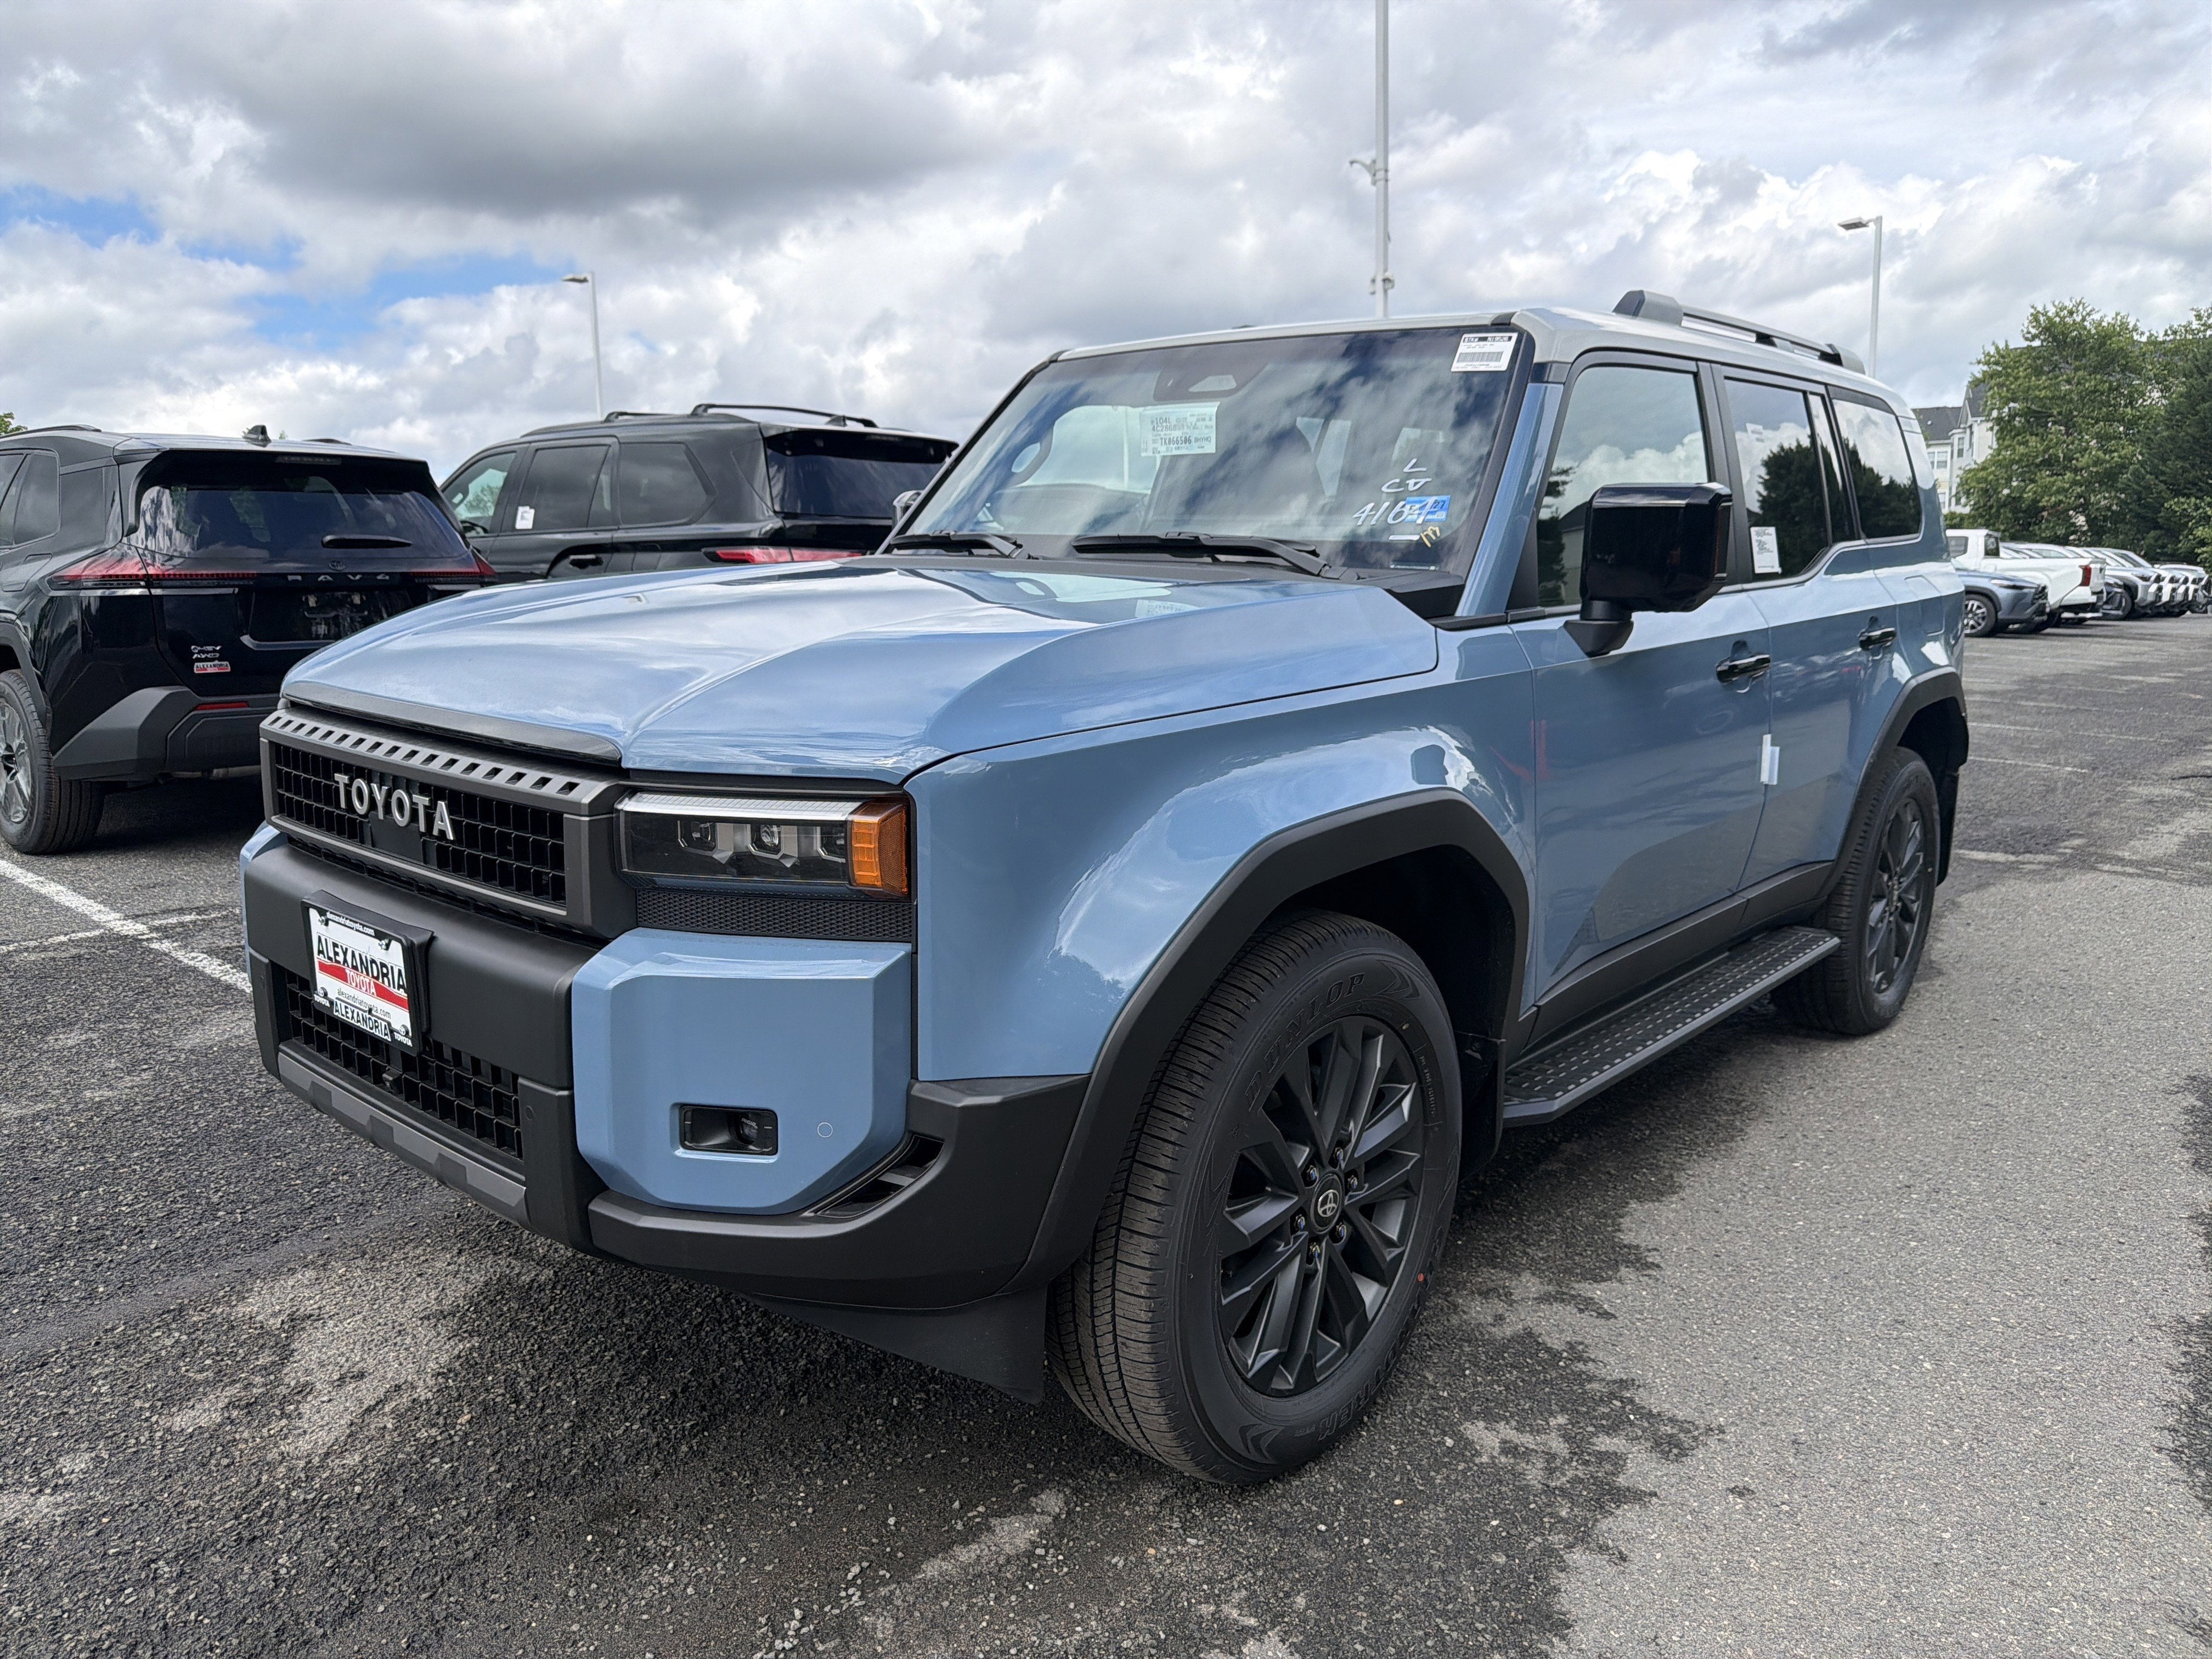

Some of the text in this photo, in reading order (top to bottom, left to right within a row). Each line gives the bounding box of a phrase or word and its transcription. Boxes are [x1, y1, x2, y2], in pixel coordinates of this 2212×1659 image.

[334, 772, 455, 841] TOYOTA
[317, 935, 407, 992] ALEXANDRIA
[345, 969, 377, 996] TOYOTA
[314, 994, 413, 1047] TOYOTA ALEXANDRIA TOYOTA
[1244, 972, 1365, 1113] DUNLOP
